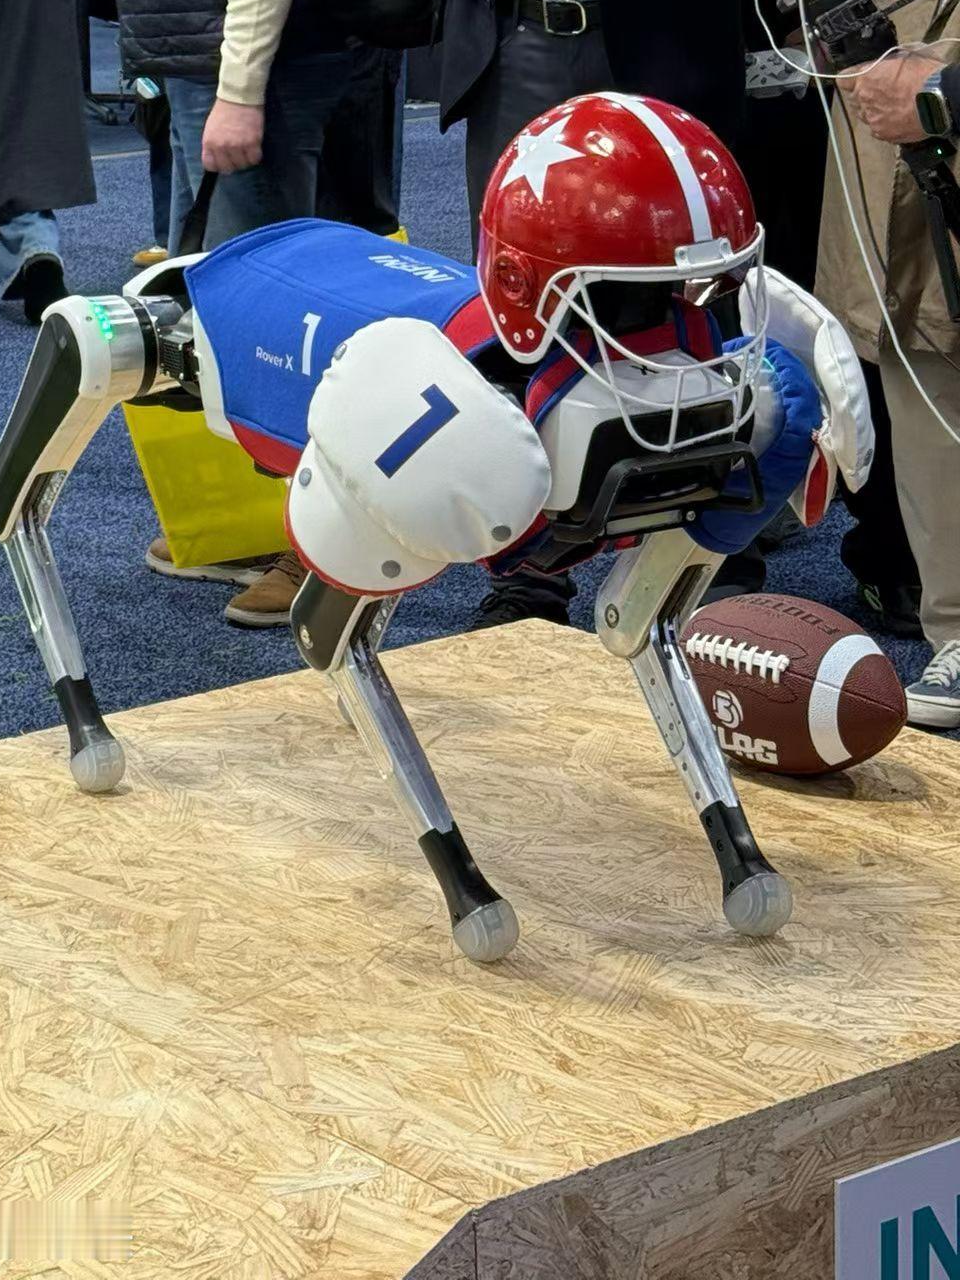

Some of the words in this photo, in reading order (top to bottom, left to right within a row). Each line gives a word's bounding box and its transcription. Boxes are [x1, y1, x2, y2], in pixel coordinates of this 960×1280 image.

[255, 345, 284, 368] Rover
[285, 354, 294, 371] X
[301, 312, 322, 377] 1
[374, 383, 460, 479] 1
[711, 722, 779, 766] LAG
[880, 1192, 960, 1280] IN
